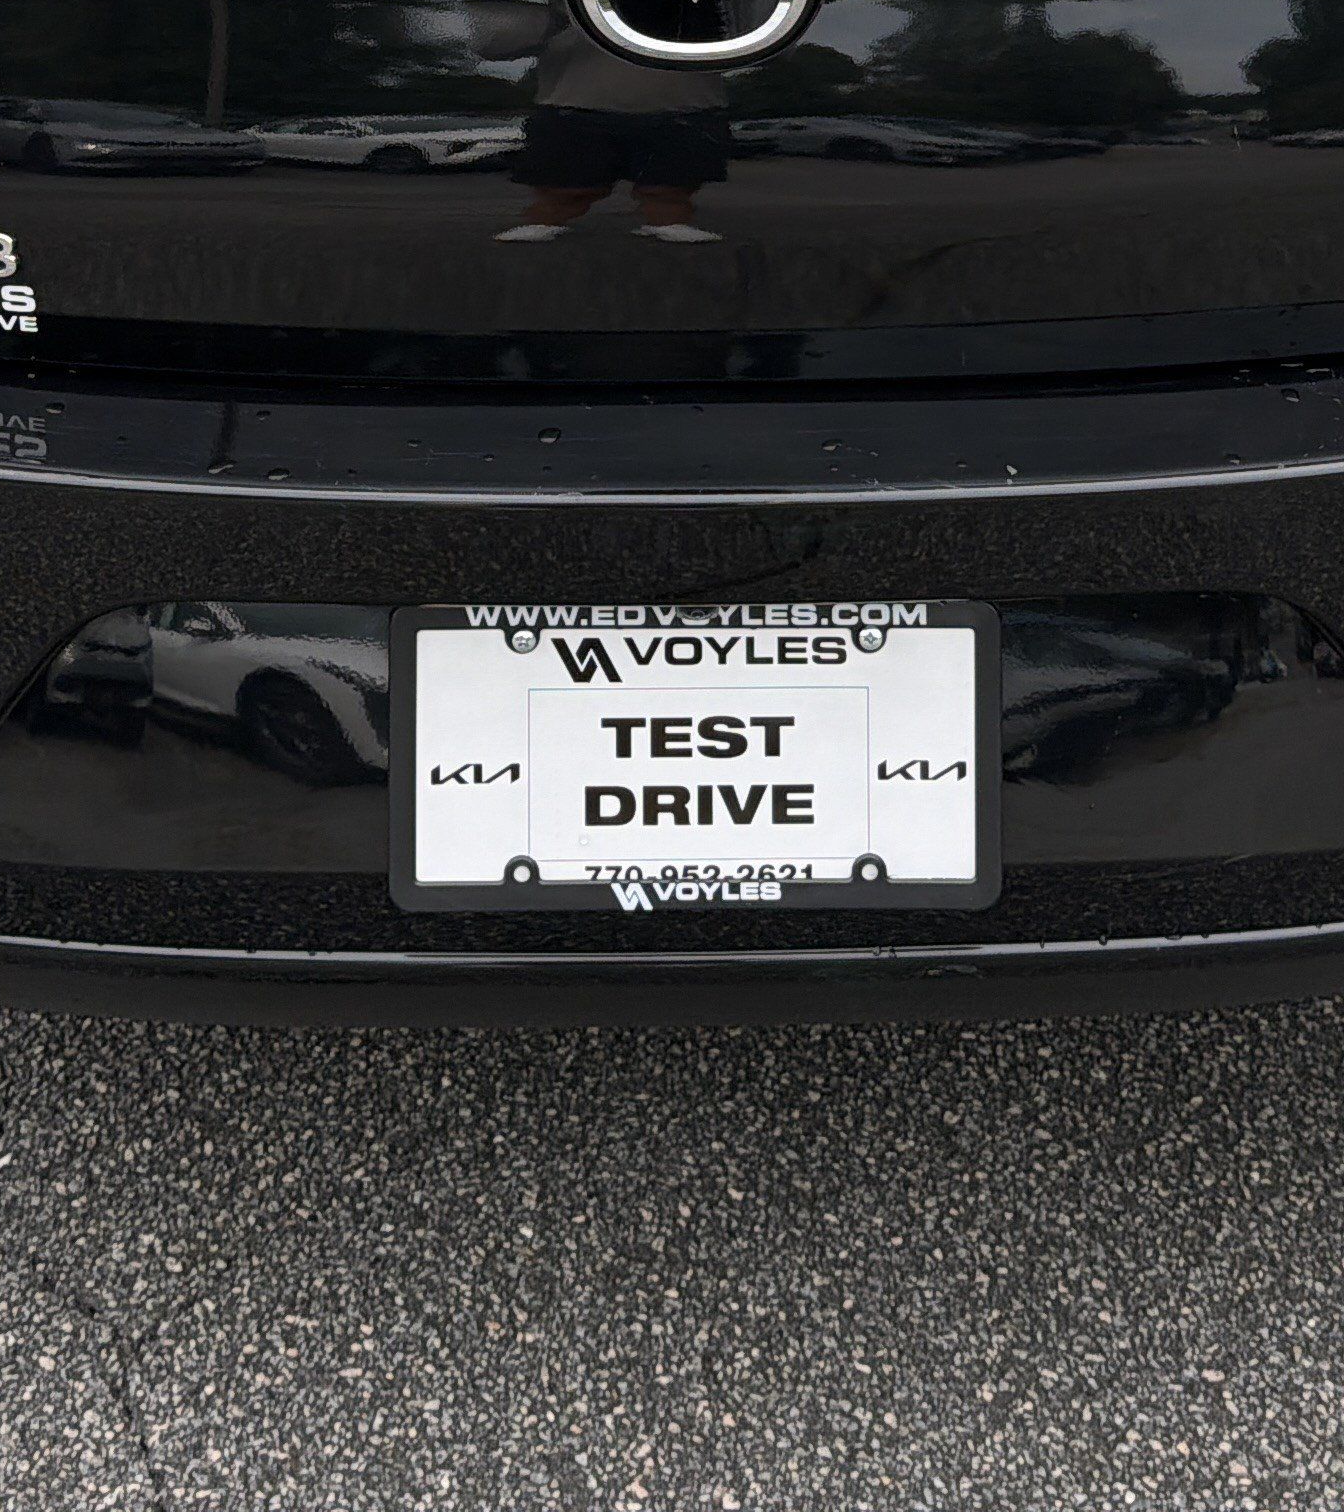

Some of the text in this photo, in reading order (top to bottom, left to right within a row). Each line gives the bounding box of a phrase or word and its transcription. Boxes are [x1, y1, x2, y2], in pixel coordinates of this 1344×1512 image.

[623, 636, 848, 666] VOYLES
[600, 716, 796, 759] TEST
[584, 783, 815, 827] DRIVE
[584, 863, 814, 880] 770-952-2621
[652, 881, 782, 901] VOYLES
